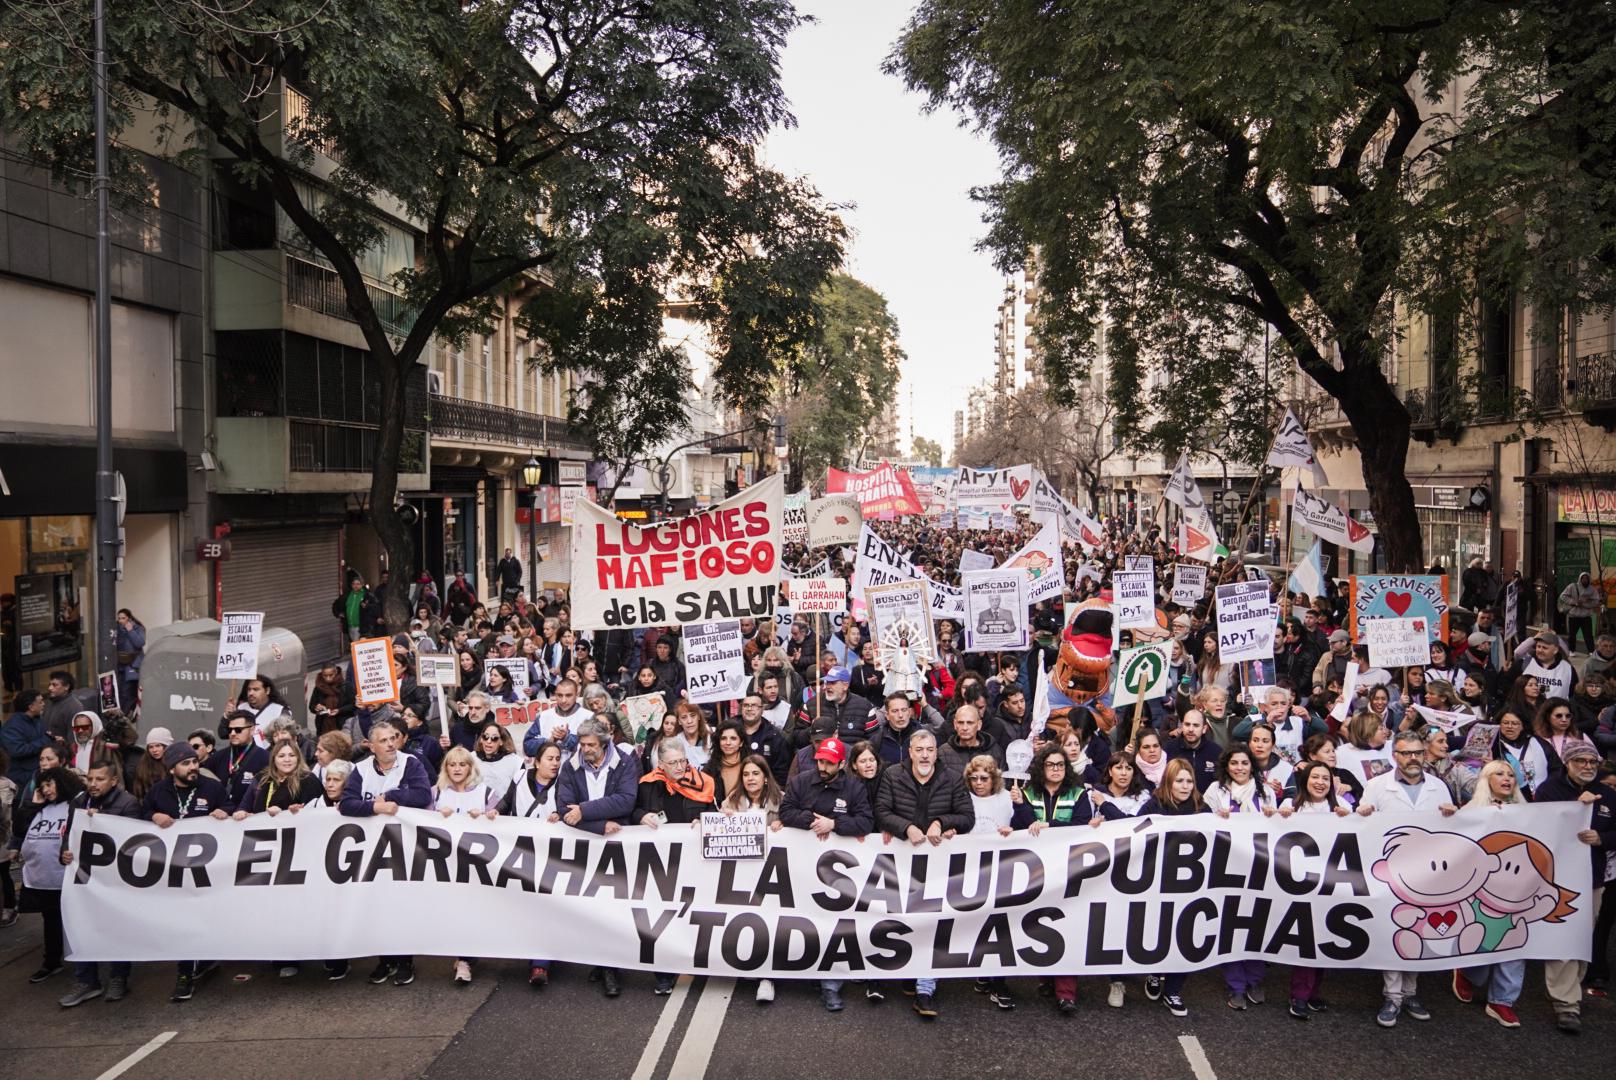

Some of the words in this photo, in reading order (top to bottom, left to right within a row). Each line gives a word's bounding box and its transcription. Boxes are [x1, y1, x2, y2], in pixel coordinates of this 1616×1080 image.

[845, 467, 900, 492] HOSPITAL
[856, 483, 904, 502] RRAHAN
[783, 507, 806, 519] PITA
[1310, 511, 1346, 527] Garrahan
[595, 501, 770, 556] LUGONES
[808, 580, 827, 590] VIVA
[971, 581, 1017, 591] BUSCADO
[1028, 579, 1061, 600] rrahan
[1121, 583, 1128, 591] ES
[1128, 582, 1146, 590] CAUSA
[790, 592, 799, 600] EL
[802, 591, 845, 600] GARRAHAN
[875, 592, 920, 605] BUSCADO
[1121, 590, 1149, 598] NACIONAL
[1174, 590, 1194, 598] APyT
[1222, 597, 1238, 608] paro
[1238, 592, 1267, 603] nacional
[603, 598, 636, 626] de
[639, 597, 665, 623] la
[798, 601, 838, 611] ¡CARAJO!
[1119, 605, 1142, 618] PyT
[1219, 607, 1270, 623] Garrahan
[228, 626, 234, 634] ES
[234, 625, 252, 634] CAUSA
[226, 634, 254, 643] NACIONAL
[689, 637, 707, 648] paro
[707, 631, 739, 644] nacional
[1220, 628, 1256, 648] APyT
[711, 643, 718, 651] el
[219, 652, 244, 666] APyT
[687, 648, 742, 664] Garrahan
[689, 669, 727, 690] APyT
[31, 819, 66, 833] APyT
[704, 816, 726, 826] NADIE
[728, 816, 737, 825] SE
[740, 816, 763, 826] SALVA
[725, 826, 742, 834] SOLO
[708, 837, 747, 848] GARRAHAN
[748, 836, 756, 846] ES
[704, 847, 727, 858] CAUSA
[727, 845, 762, 857] NACIONAL
[73, 828, 219, 888] POR
[233, 827, 308, 887] EL
[324, 823, 697, 918] GARRAHAN,
[715, 846, 796, 909] LA
[811, 848, 1045, 914] SALUD
[1063, 818, 1370, 899] PÚBLICA
[689, 910, 913, 972] TODAS
[931, 906, 1066, 971] LAS
[1084, 895, 1374, 967] LUCHAS
